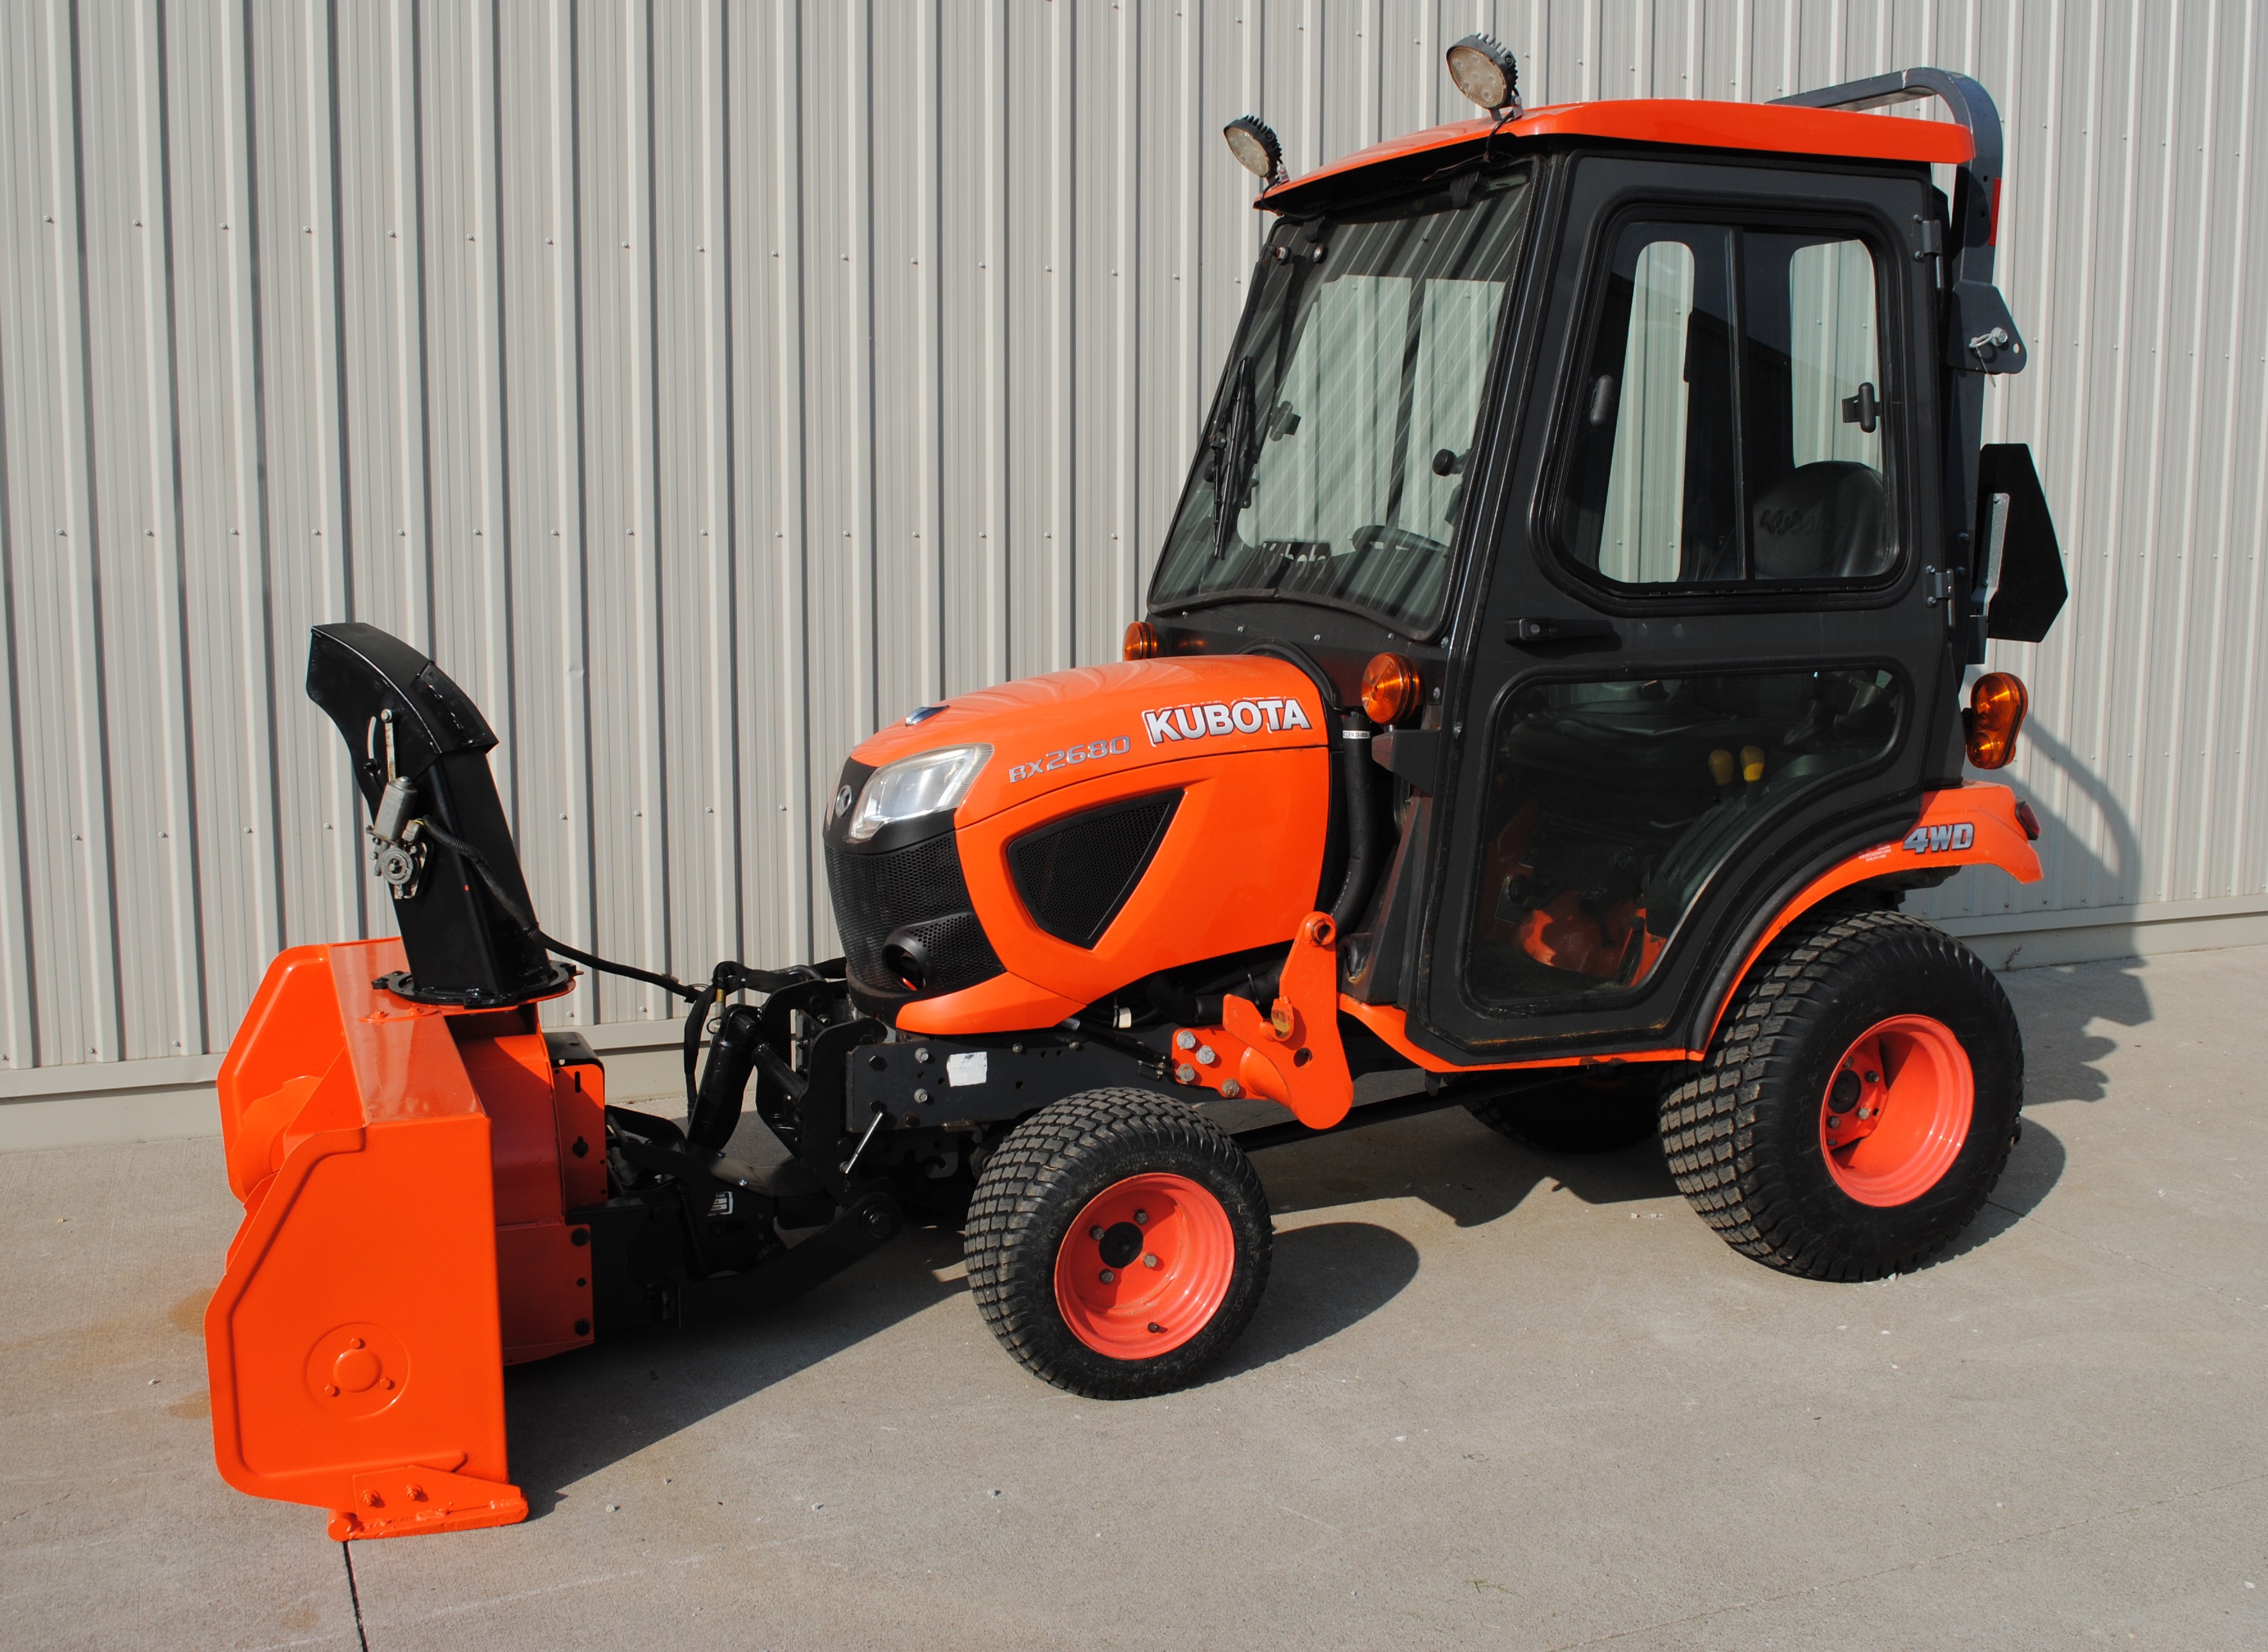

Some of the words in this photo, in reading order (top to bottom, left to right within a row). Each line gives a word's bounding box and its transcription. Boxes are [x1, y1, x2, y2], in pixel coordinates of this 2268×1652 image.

[1143, 699, 1312, 745] KUBOTA
[1008, 736, 1131, 783] BX2680
[1903, 822, 1974, 854] 4WD
